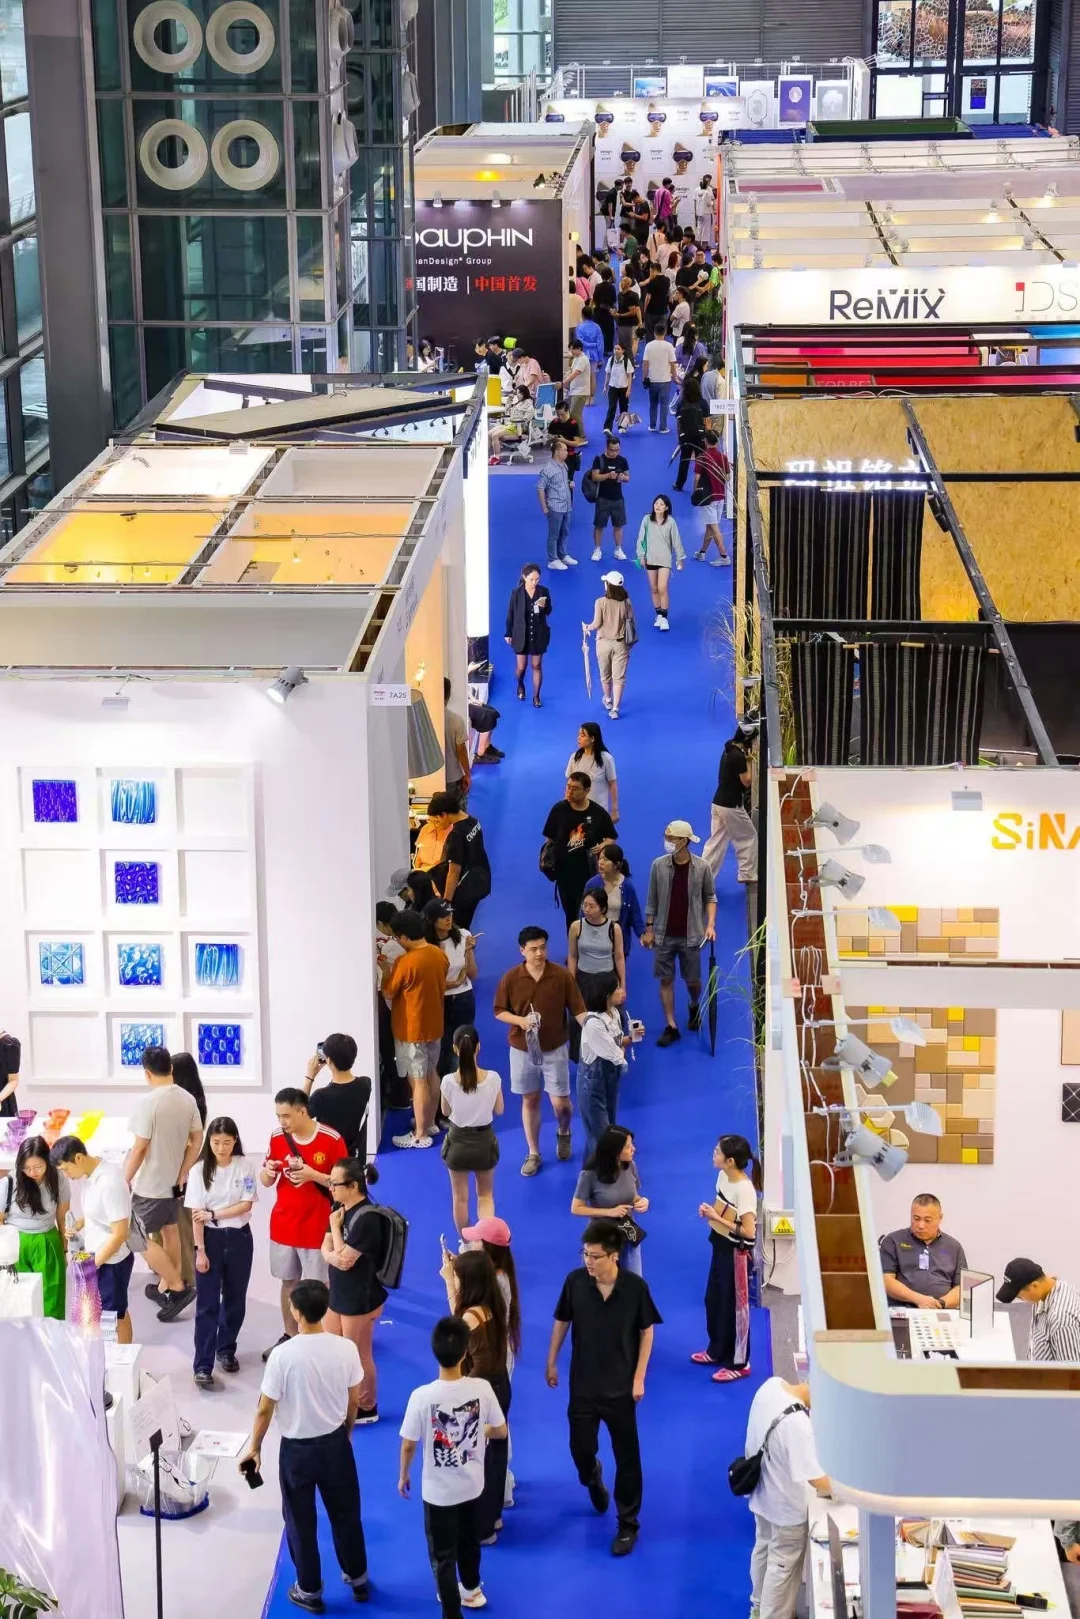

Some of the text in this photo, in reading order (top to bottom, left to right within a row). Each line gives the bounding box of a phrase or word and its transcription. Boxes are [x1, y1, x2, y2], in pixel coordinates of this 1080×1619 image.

[466, 257, 492, 266] Group
[475, 276, 537, 292] 中国首发
[992, 812, 1080, 850] SiN
